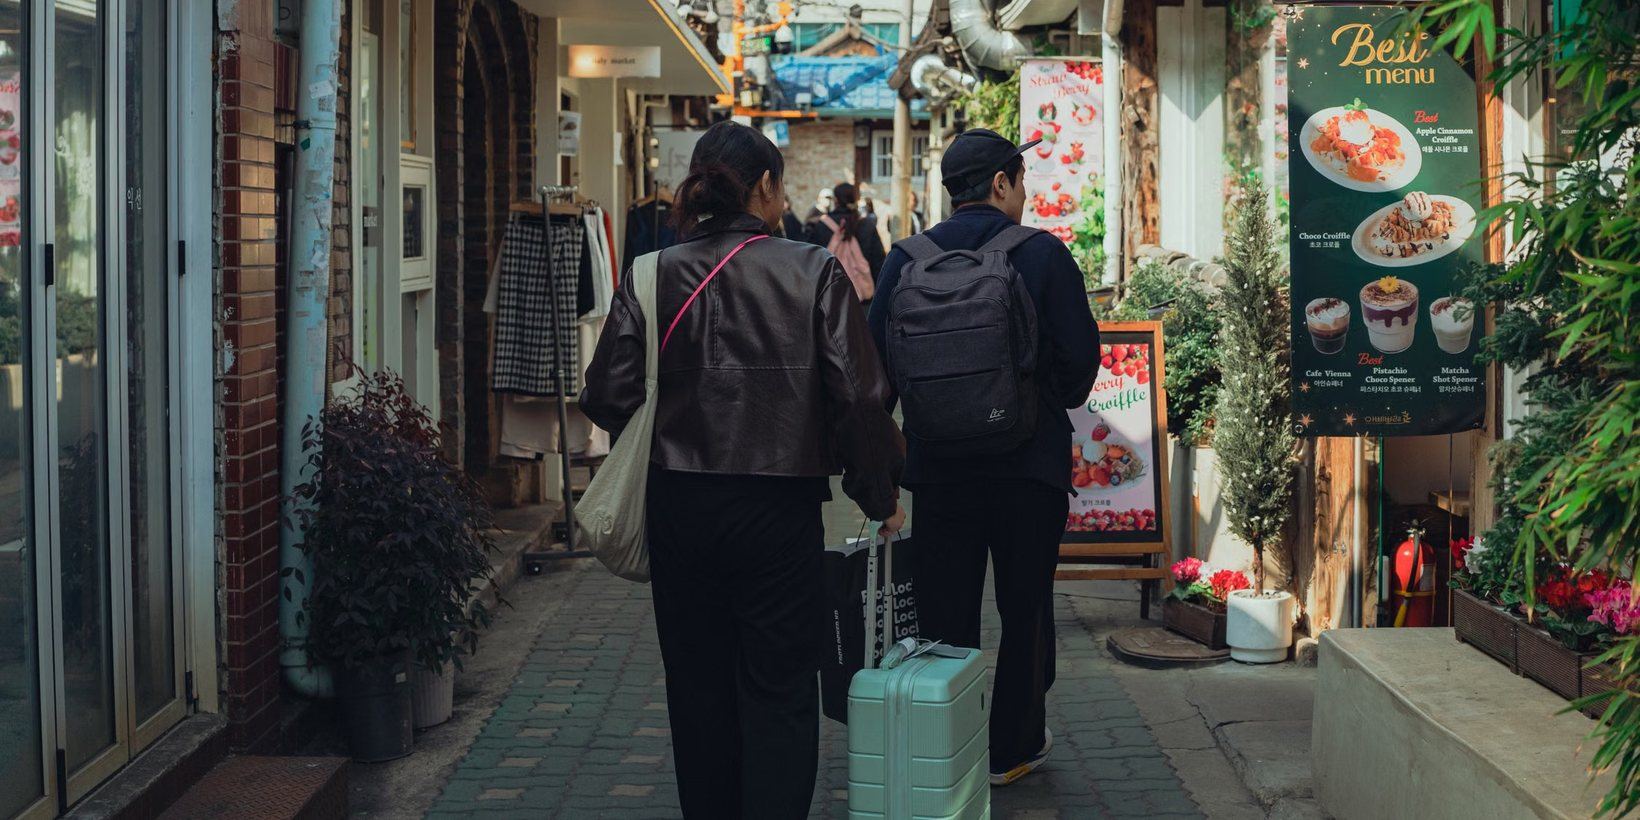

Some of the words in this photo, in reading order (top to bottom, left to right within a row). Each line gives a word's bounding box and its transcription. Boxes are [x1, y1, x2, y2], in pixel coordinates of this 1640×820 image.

[1331, 23, 1430, 66] Best
[1365, 67, 1436, 84] menu
[1415, 110, 1438, 123] Best
[1416, 127, 1436, 136] Apple
[1437, 127, 1473, 135] Cinnamon
[1434, 145, 1450, 153] 시나몬
[1299, 232, 1322, 240] Choco
[1322, 232, 1351, 240] Croiffle
[1358, 353, 1383, 365] Best
[1305, 369, 1323, 377] Cafe
[1441, 366, 1470, 374] Matcha
[1093, 377, 1124, 392] erry
[1389, 376, 1416, 385] Spener
[1432, 375, 1451, 383] Shot
[1451, 375, 1478, 384] Spener
[1088, 388, 1146, 413] Croiffle
[891, 577, 913, 596] Loc
[893, 596, 915, 610] Loc
